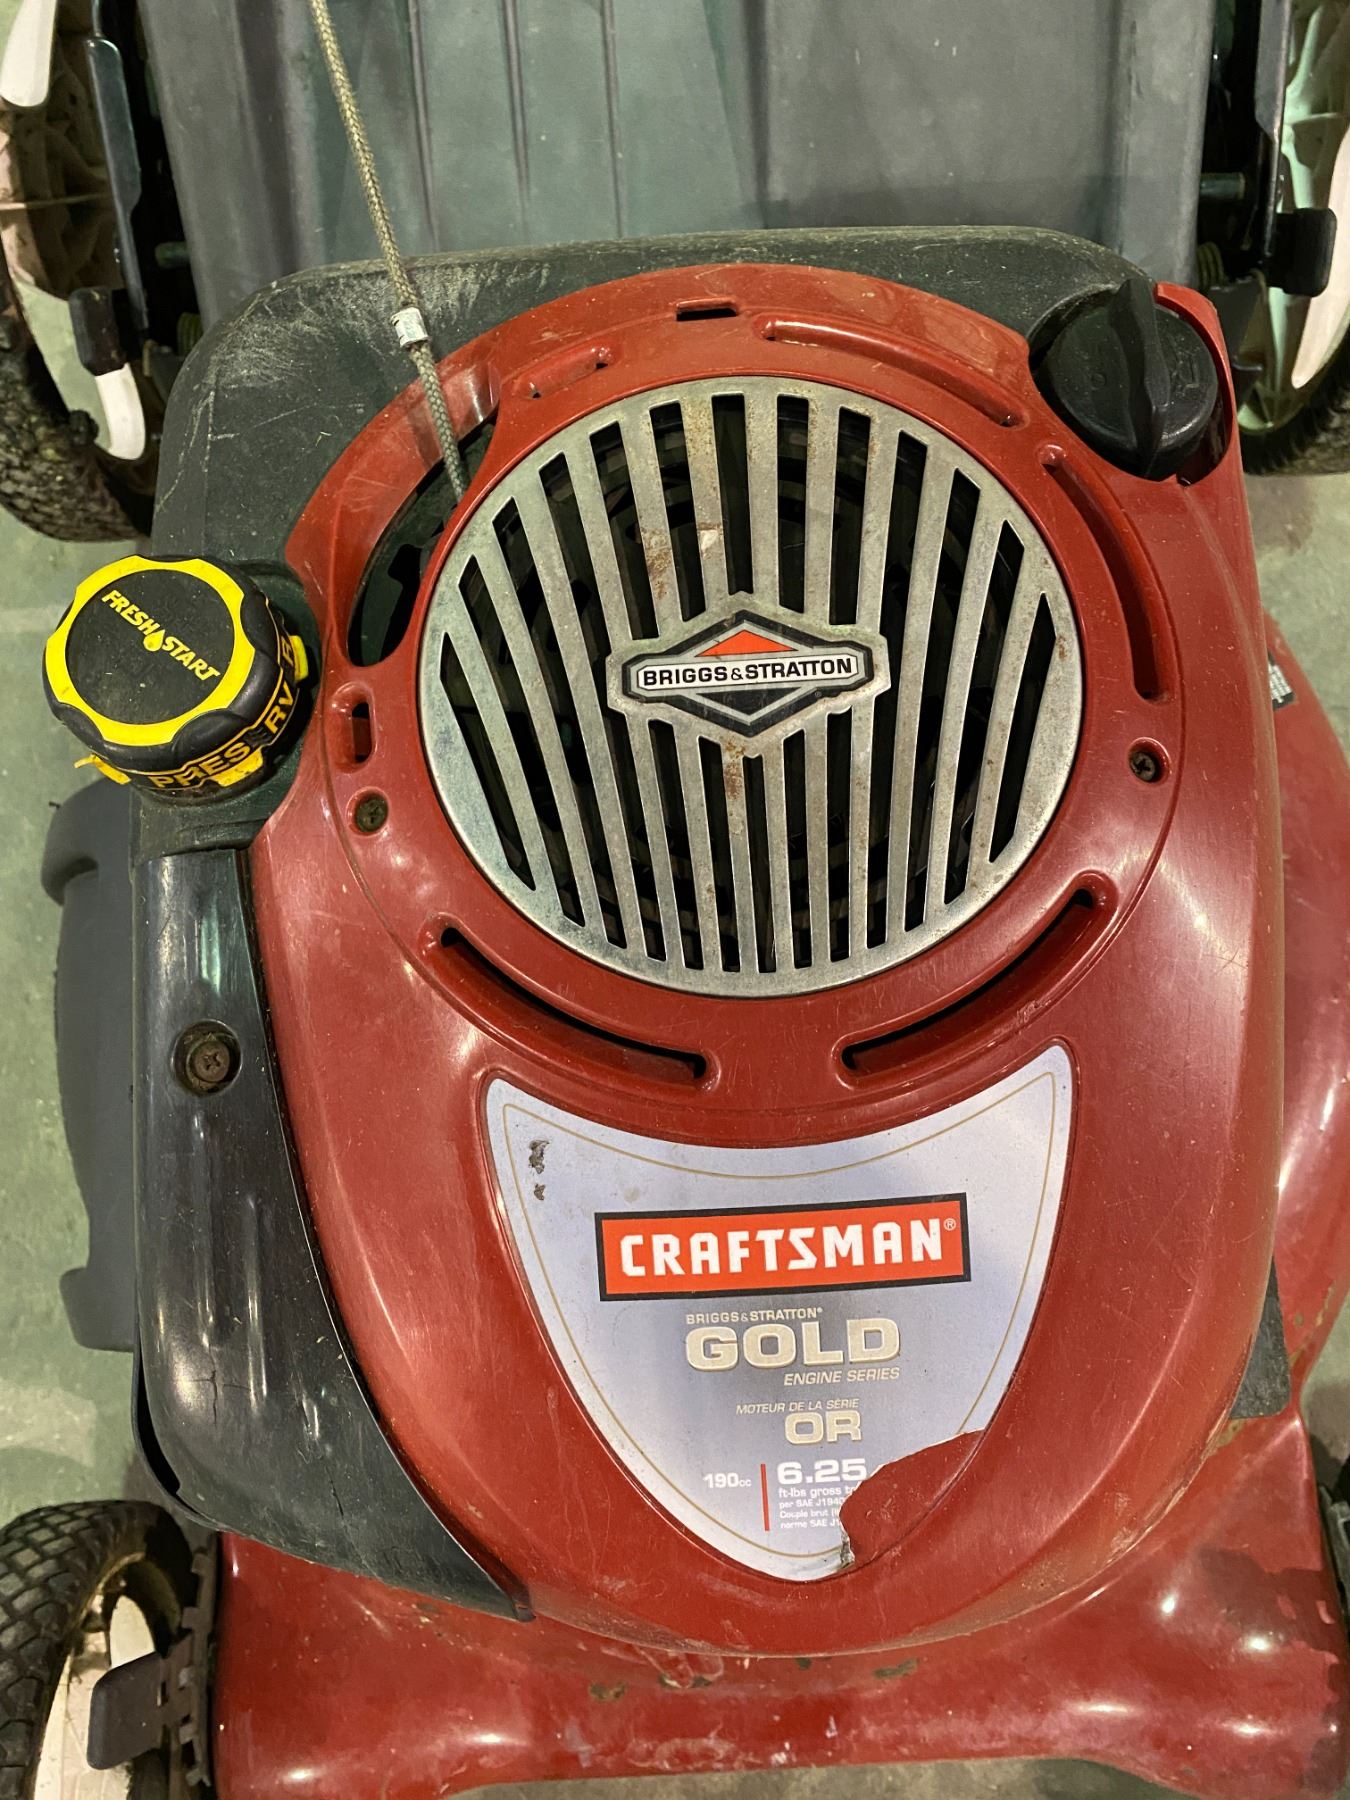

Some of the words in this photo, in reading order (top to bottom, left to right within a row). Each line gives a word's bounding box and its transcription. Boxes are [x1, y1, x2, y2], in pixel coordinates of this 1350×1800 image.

[101, 589, 158, 639] FRESH
[161, 635, 221, 681] START
[643, 658, 852, 686] BRIGGS&STRATTON
[686, 1318, 900, 1371] GOLD
[783, 1371, 842, 1386] ENGINE
[847, 1367, 900, 1382] SERIES
[736, 1402, 785, 1415] MOTEUR
[789, 1402, 804, 1411] DE
[808, 1402, 822, 1410] LA
[784, 1410, 862, 1445] OR
[777, 1458, 867, 1485] 6.25
[703, 1473, 752, 1488] 190cc
[779, 1487, 807, 1498] ft-lbs
[810, 1487, 842, 1498] gross
[796, 1499, 813, 1507] SAE
[780, 1510, 808, 1519] Couple
[781, 1521, 808, 1529] norme
[810, 1519, 828, 1527] SAE
